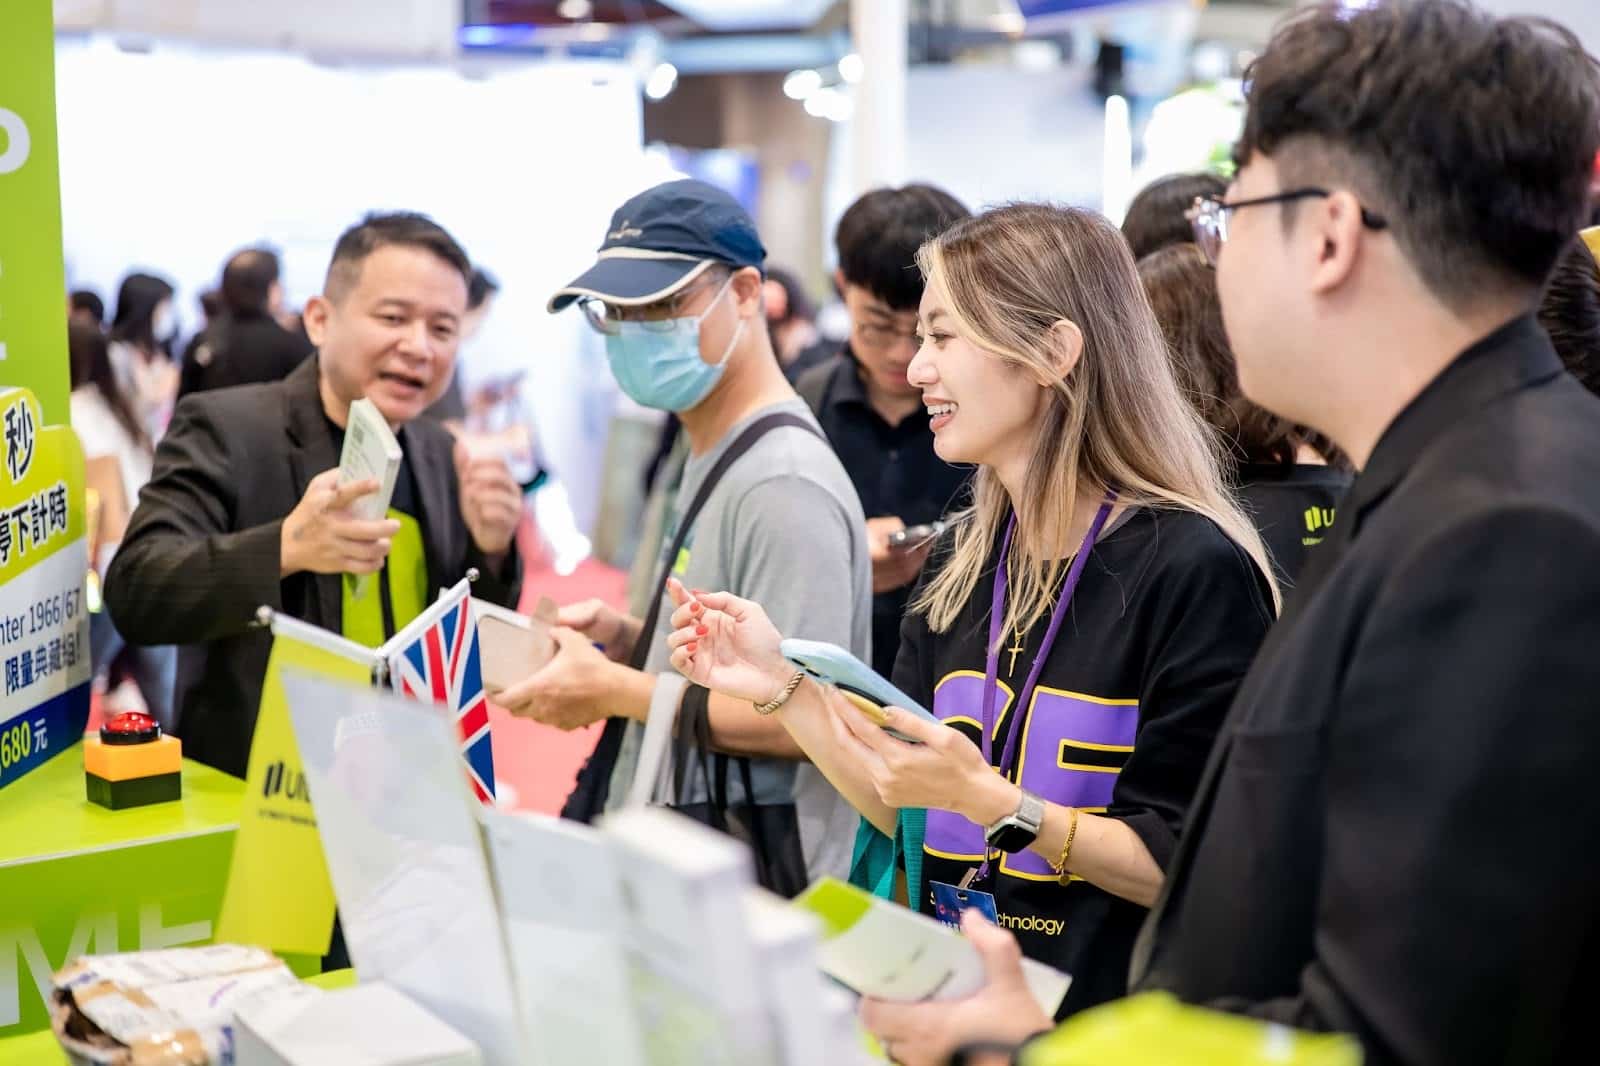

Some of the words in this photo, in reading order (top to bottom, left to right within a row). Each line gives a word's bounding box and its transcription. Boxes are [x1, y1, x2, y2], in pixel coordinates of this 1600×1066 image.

[5, 401, 33, 480] 秒
[30, 587, 80, 634] 1966/67
[34, 717, 48, 753] 元
[998, 912, 1065, 936] chnology
